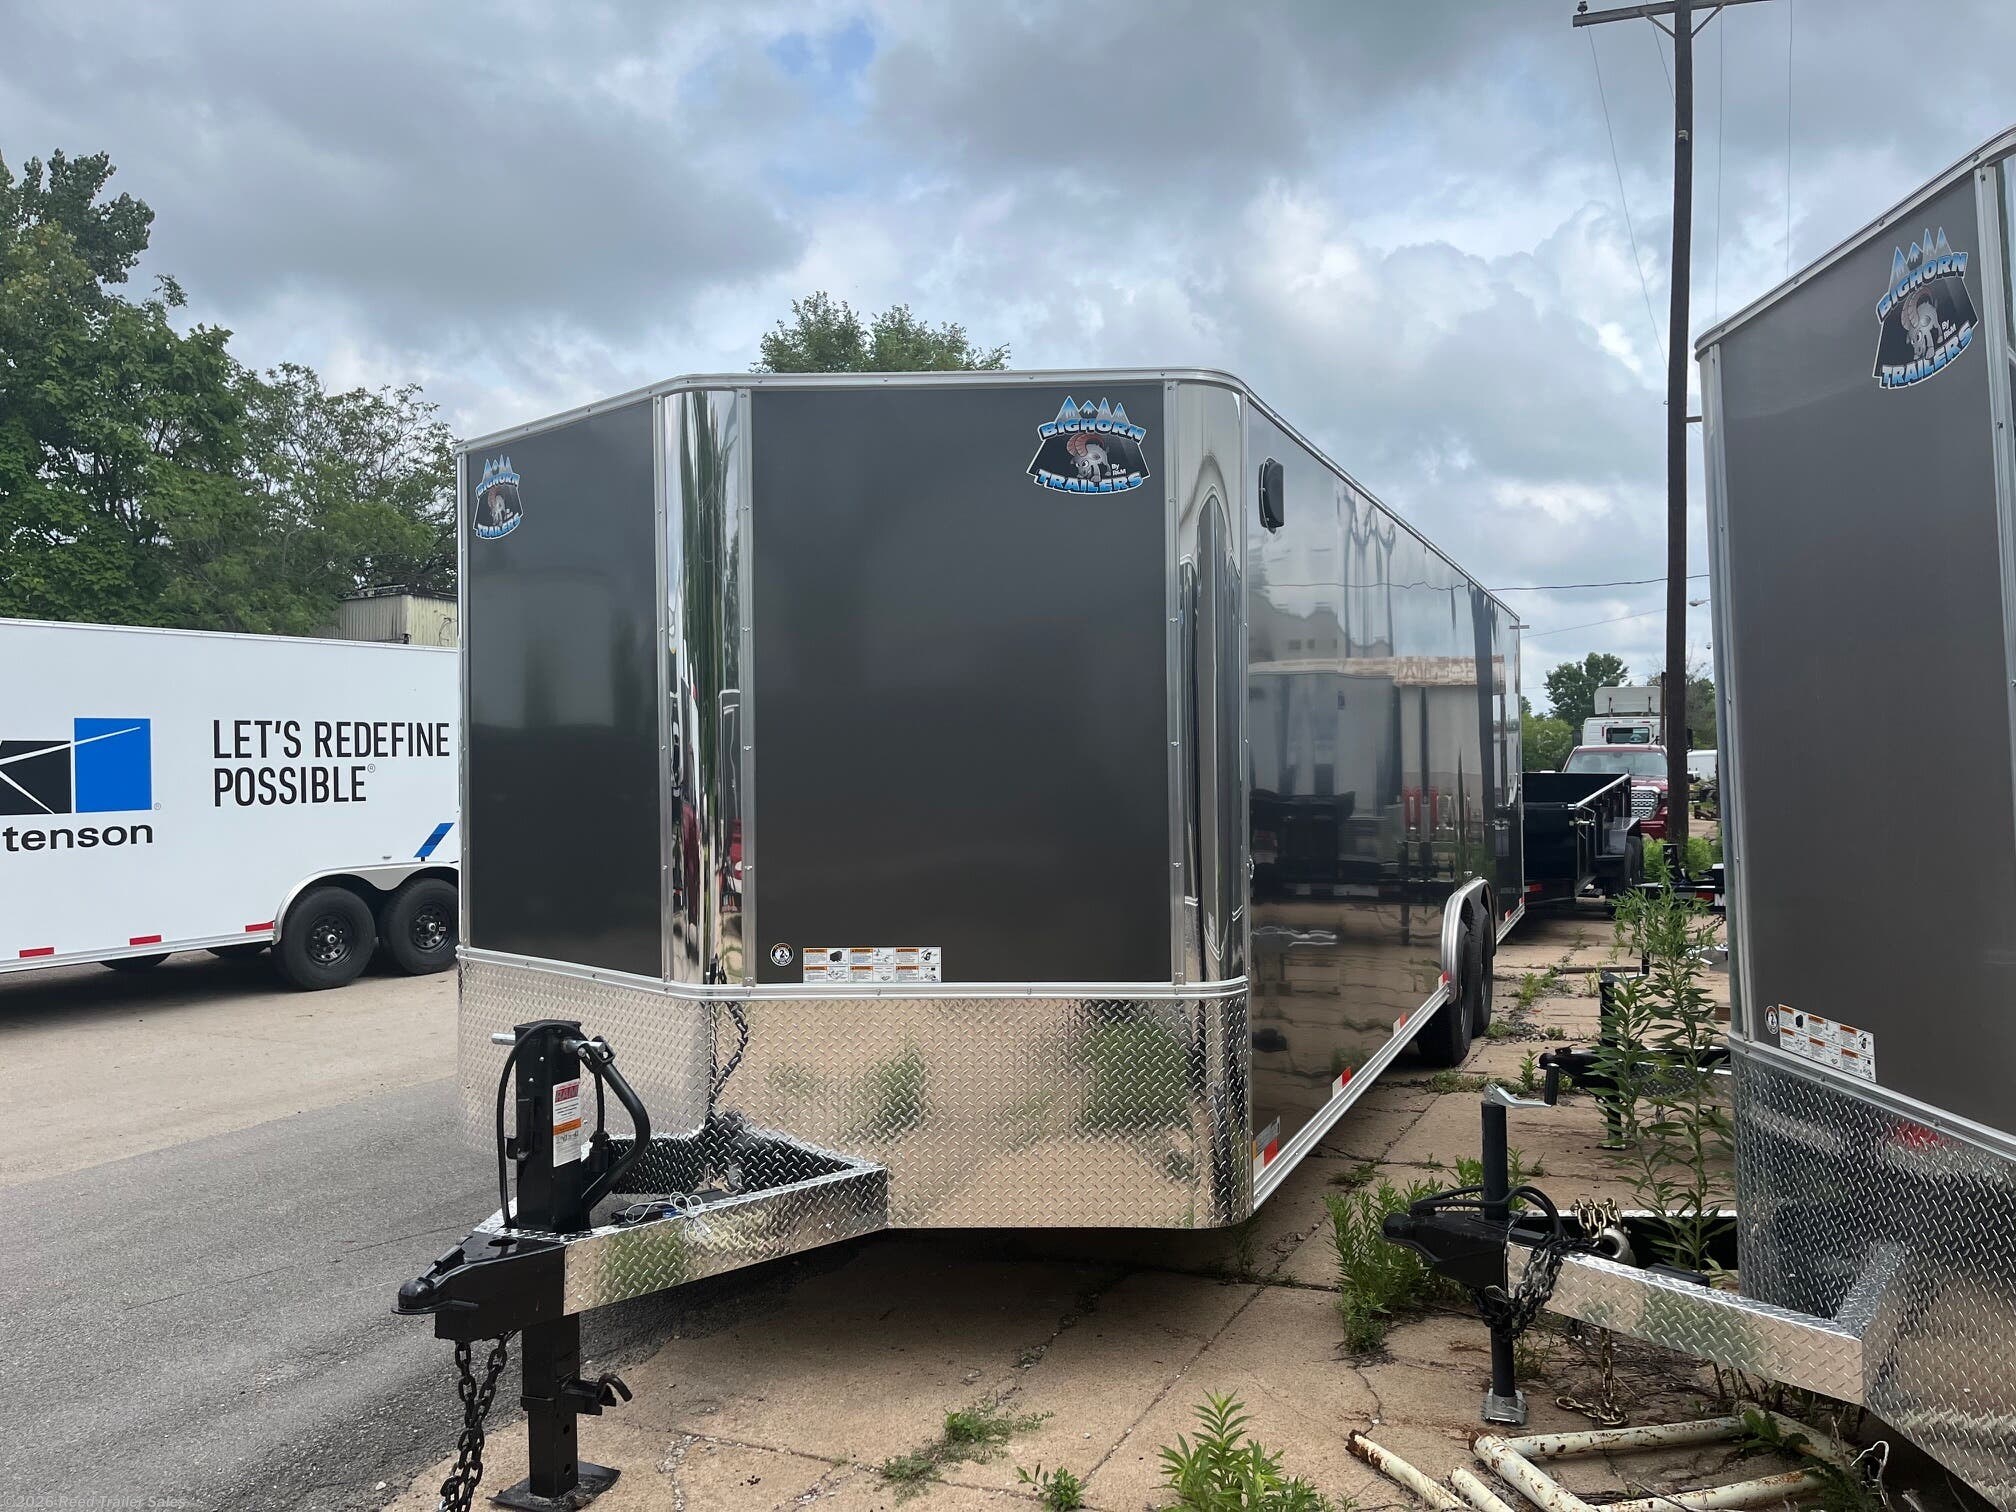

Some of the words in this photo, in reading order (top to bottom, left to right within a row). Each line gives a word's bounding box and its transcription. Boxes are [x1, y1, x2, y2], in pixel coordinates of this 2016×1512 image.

[1879, 253, 1967, 319] BIGHORN
[1881, 321, 1973, 385] TRAILERS
[1040, 418, 1145, 442] BIGHORN
[1038, 469, 1142, 492] TRAILERS
[213, 719, 301, 759] LET'S
[314, 721, 450, 758] REDEFINE
[2, 824, 153, 852] tenson
